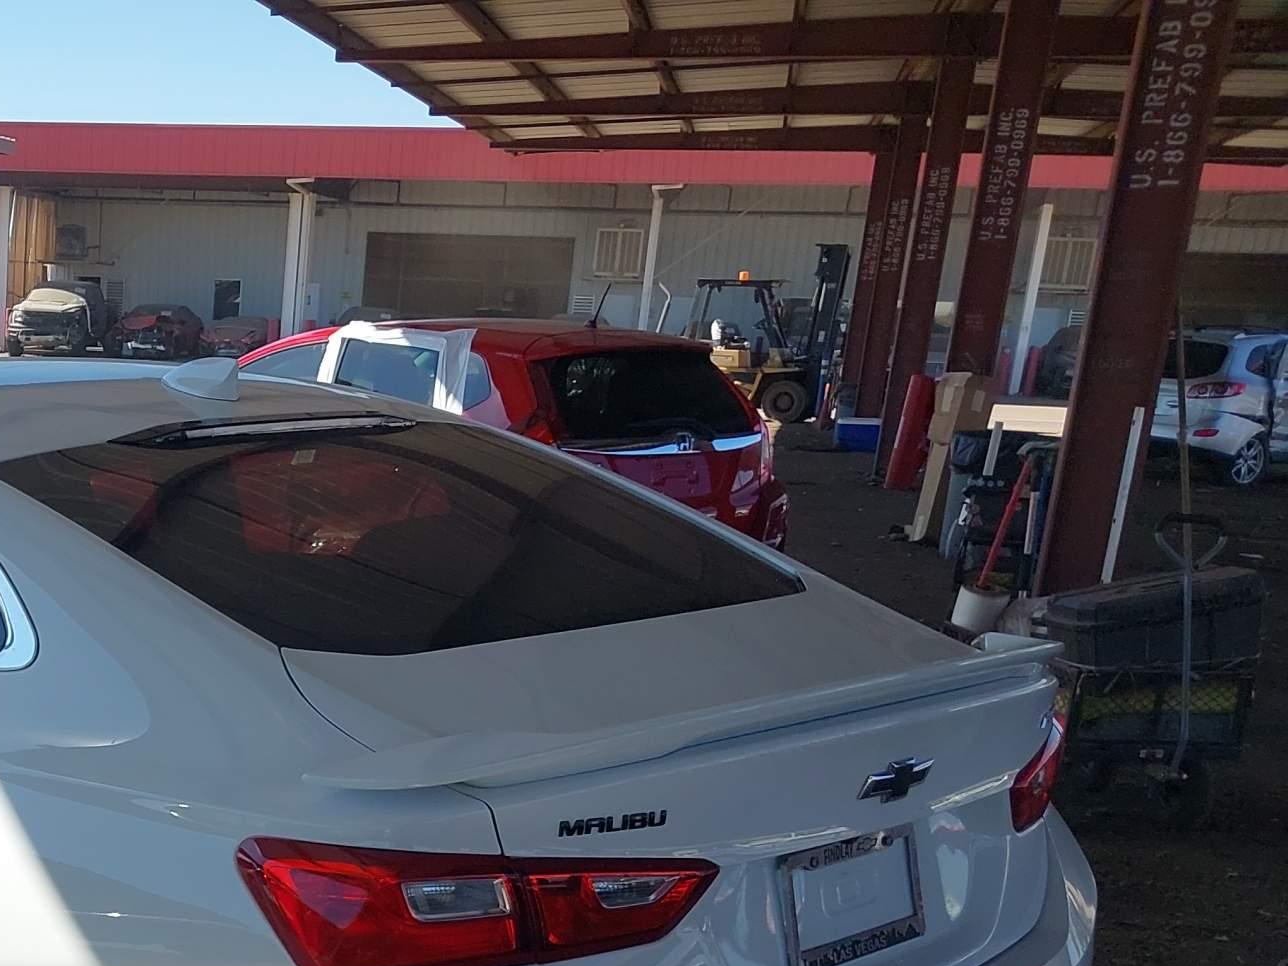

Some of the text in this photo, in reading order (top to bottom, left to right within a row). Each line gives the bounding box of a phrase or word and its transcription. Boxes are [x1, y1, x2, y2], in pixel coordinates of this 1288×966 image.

[1142, 21, 1181, 124] PREFAB
[985, 144, 1008, 203] PREFAB
[1130, 141, 1159, 188] U.S.
[558, 810, 667, 837] MALIBU
[833, 935, 887, 964] LAS VEGAS
